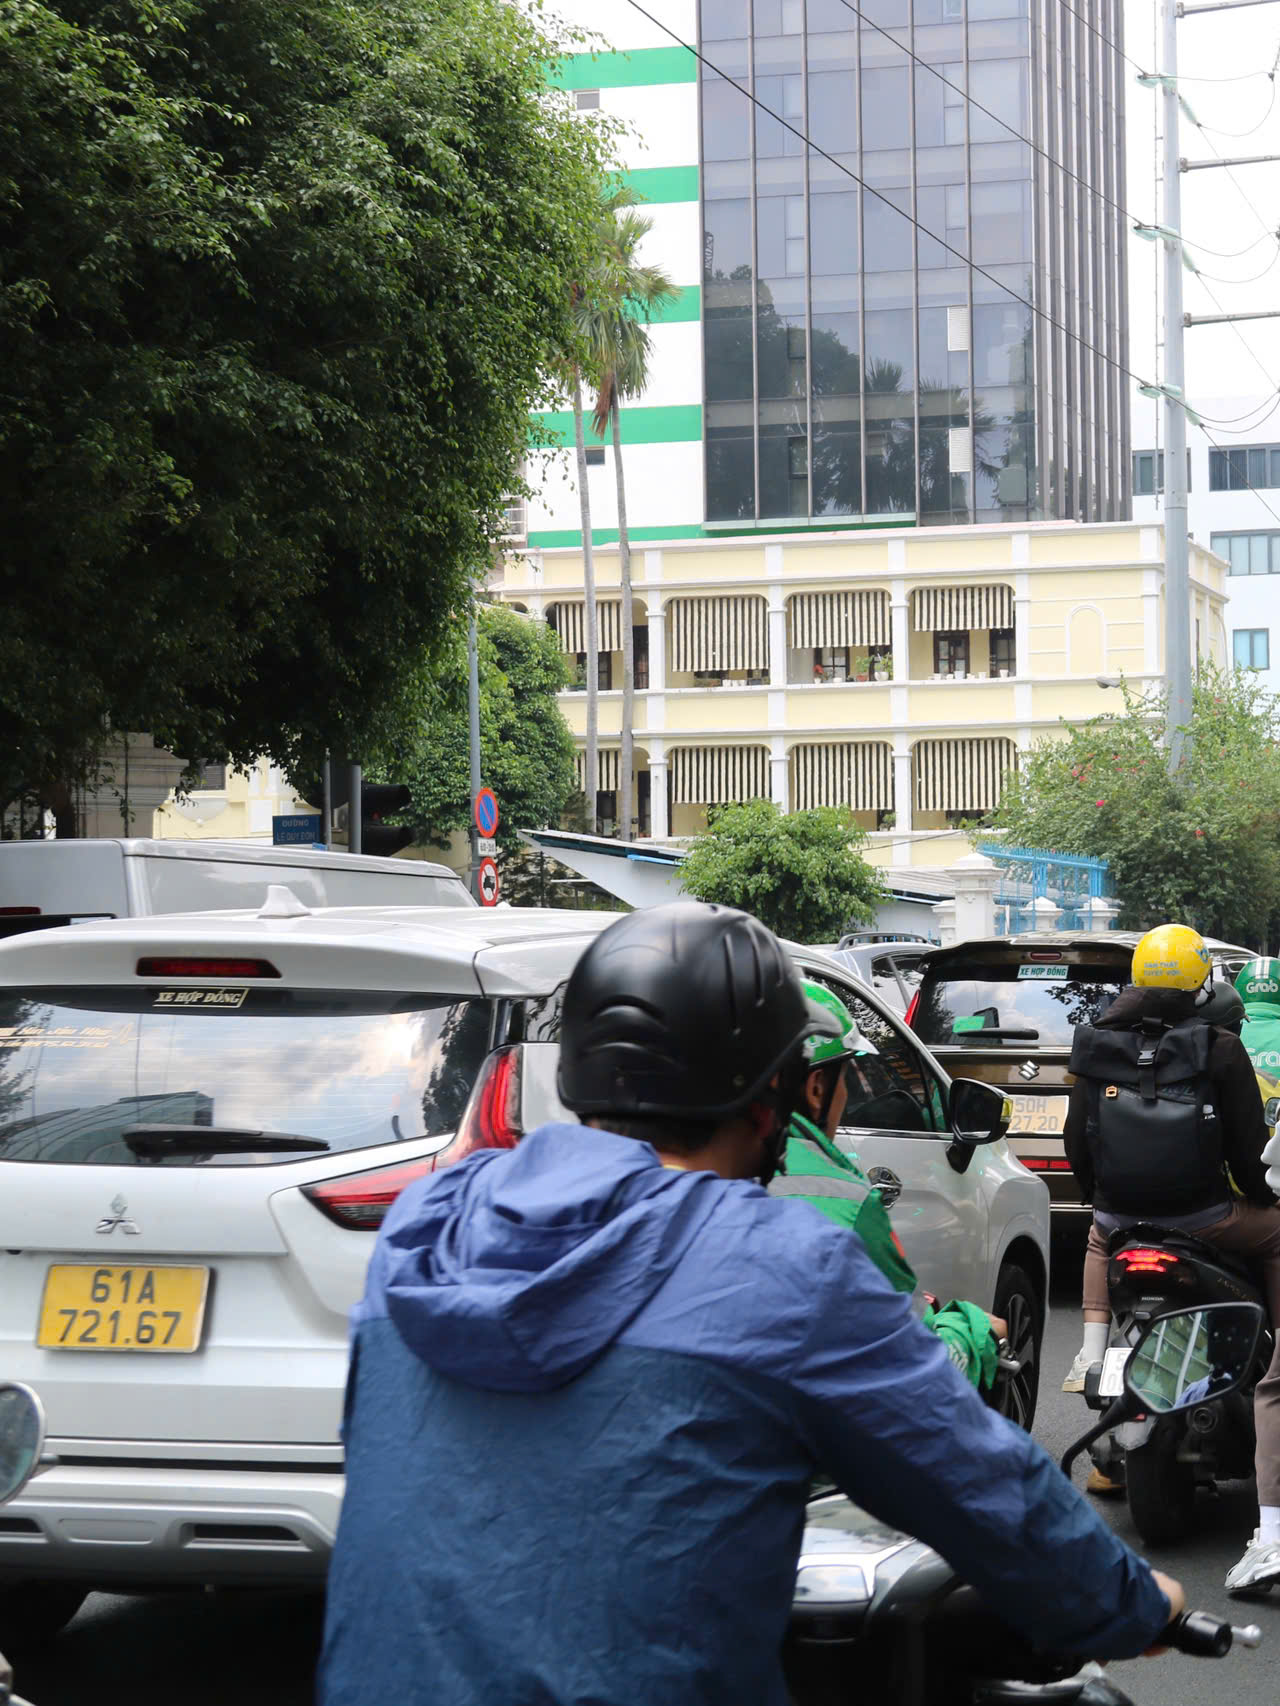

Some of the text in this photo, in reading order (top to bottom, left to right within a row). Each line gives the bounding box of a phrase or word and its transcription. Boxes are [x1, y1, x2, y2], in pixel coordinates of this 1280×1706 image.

[1019, 967, 1030, 976] XE
[1246, 980, 1279, 994] Grab
[156, 991, 173, 1003] XE
[1011, 1114, 1059, 1132] 27.20
[90, 1269, 155, 1304] 61A
[58, 1309, 182, 1345] 721.67
